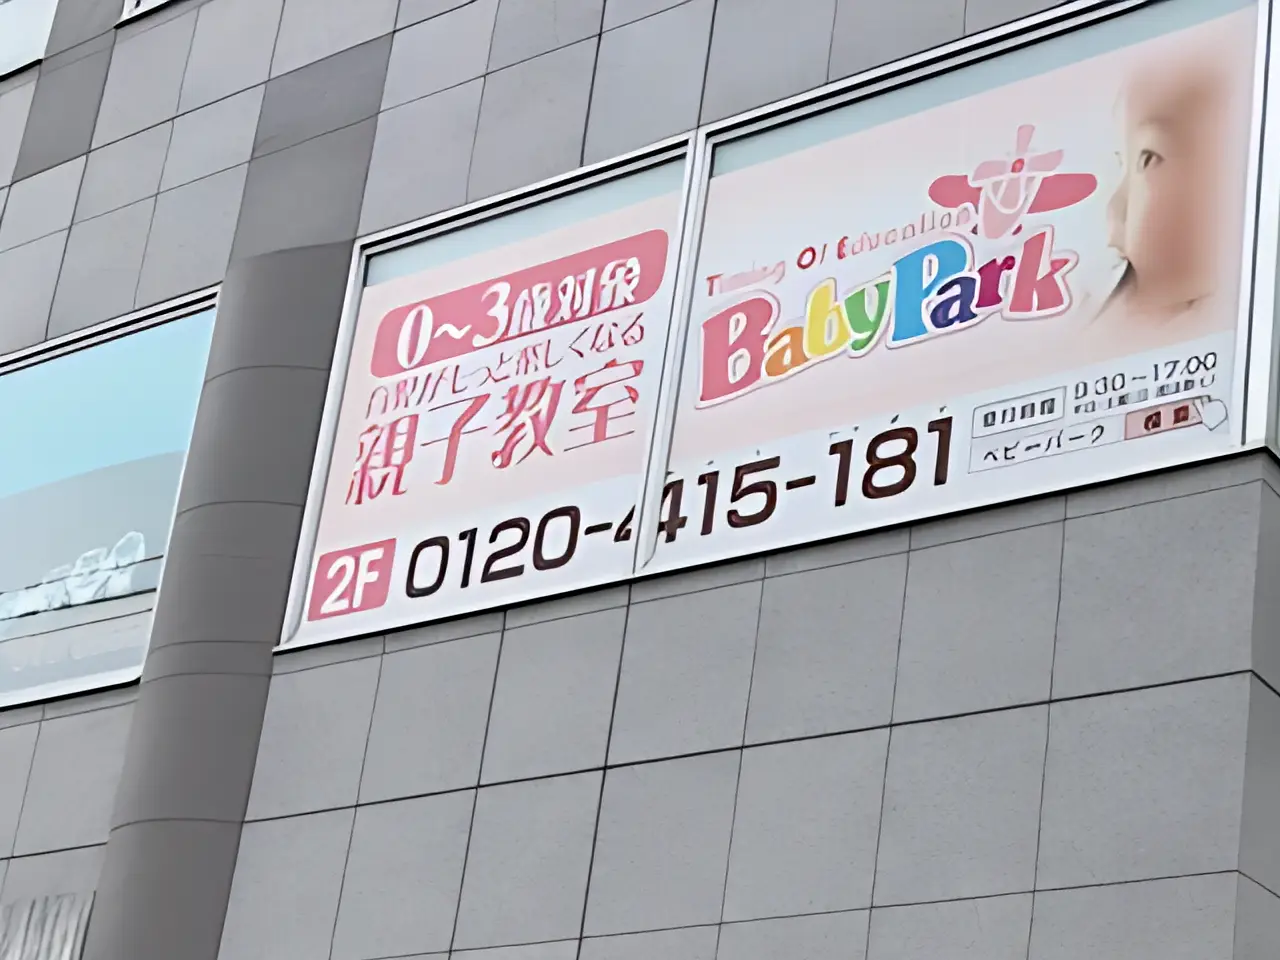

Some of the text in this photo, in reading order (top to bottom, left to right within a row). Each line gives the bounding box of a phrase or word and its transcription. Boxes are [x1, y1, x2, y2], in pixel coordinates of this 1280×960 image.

[697, 227, 1077, 404] BabyPark
[344, 357, 645, 505] 親子教室
[404, 414, 954, 600] 0120-415-181
[319, 548, 383, 615] 2F
